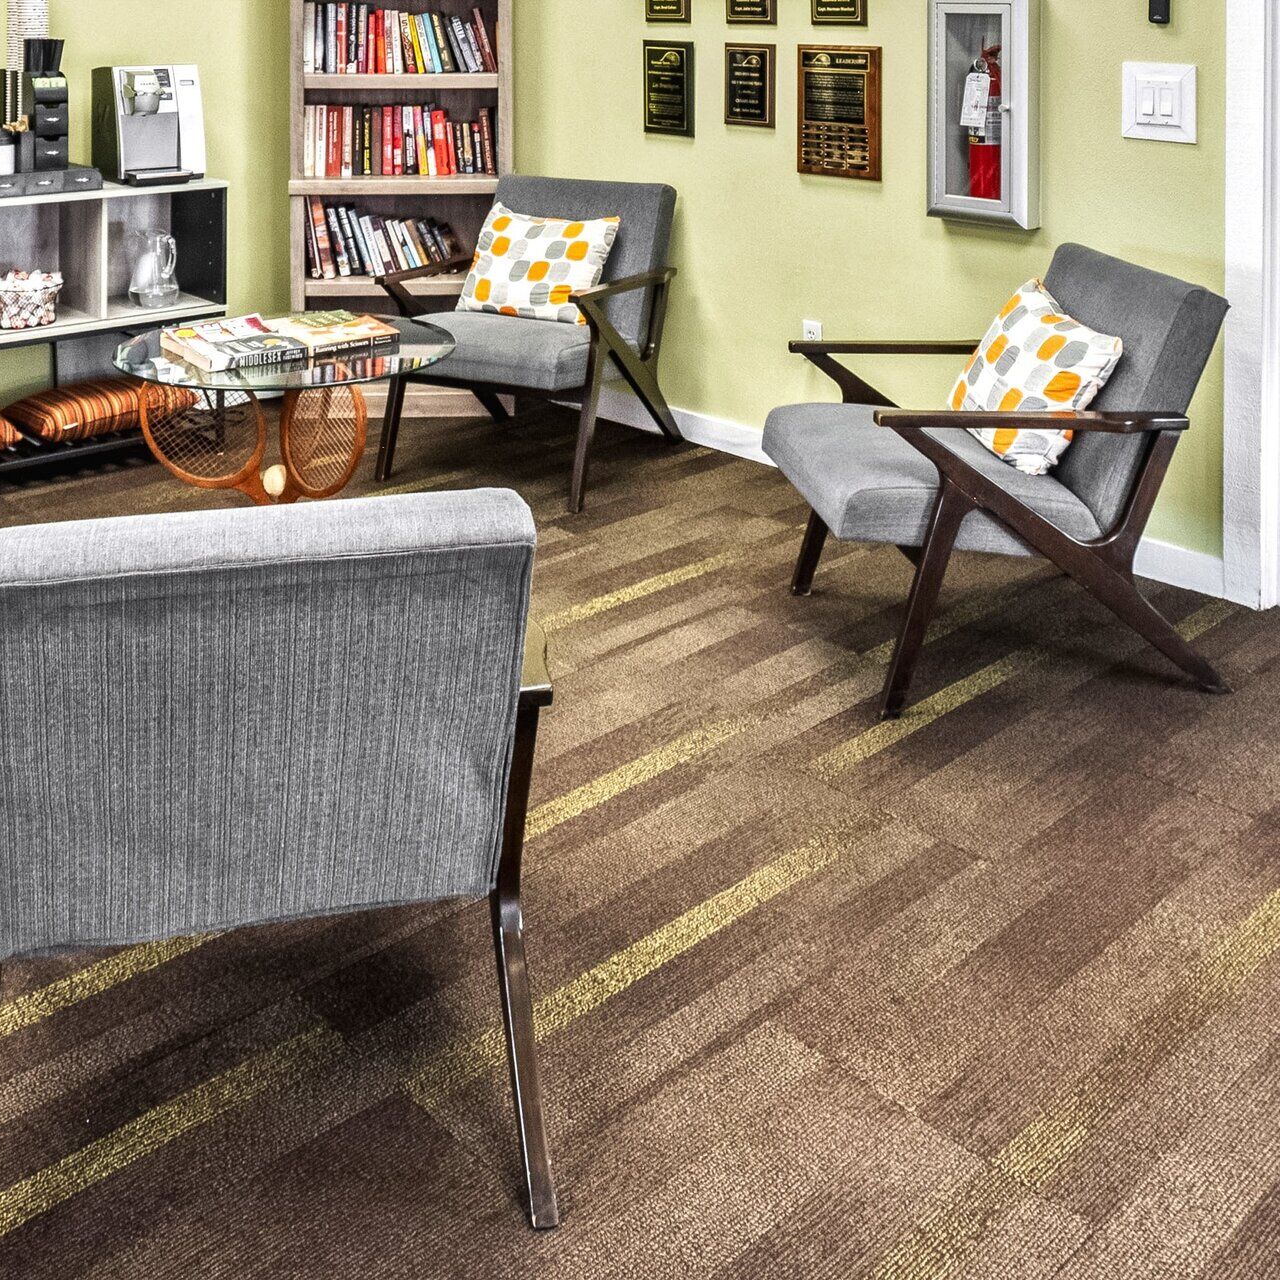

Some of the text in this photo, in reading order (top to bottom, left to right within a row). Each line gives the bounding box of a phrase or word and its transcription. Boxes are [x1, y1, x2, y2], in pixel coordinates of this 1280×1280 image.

[315, 339, 369, 354] Running with Scissors
[239, 350, 282, 368] MIDDLESEX
